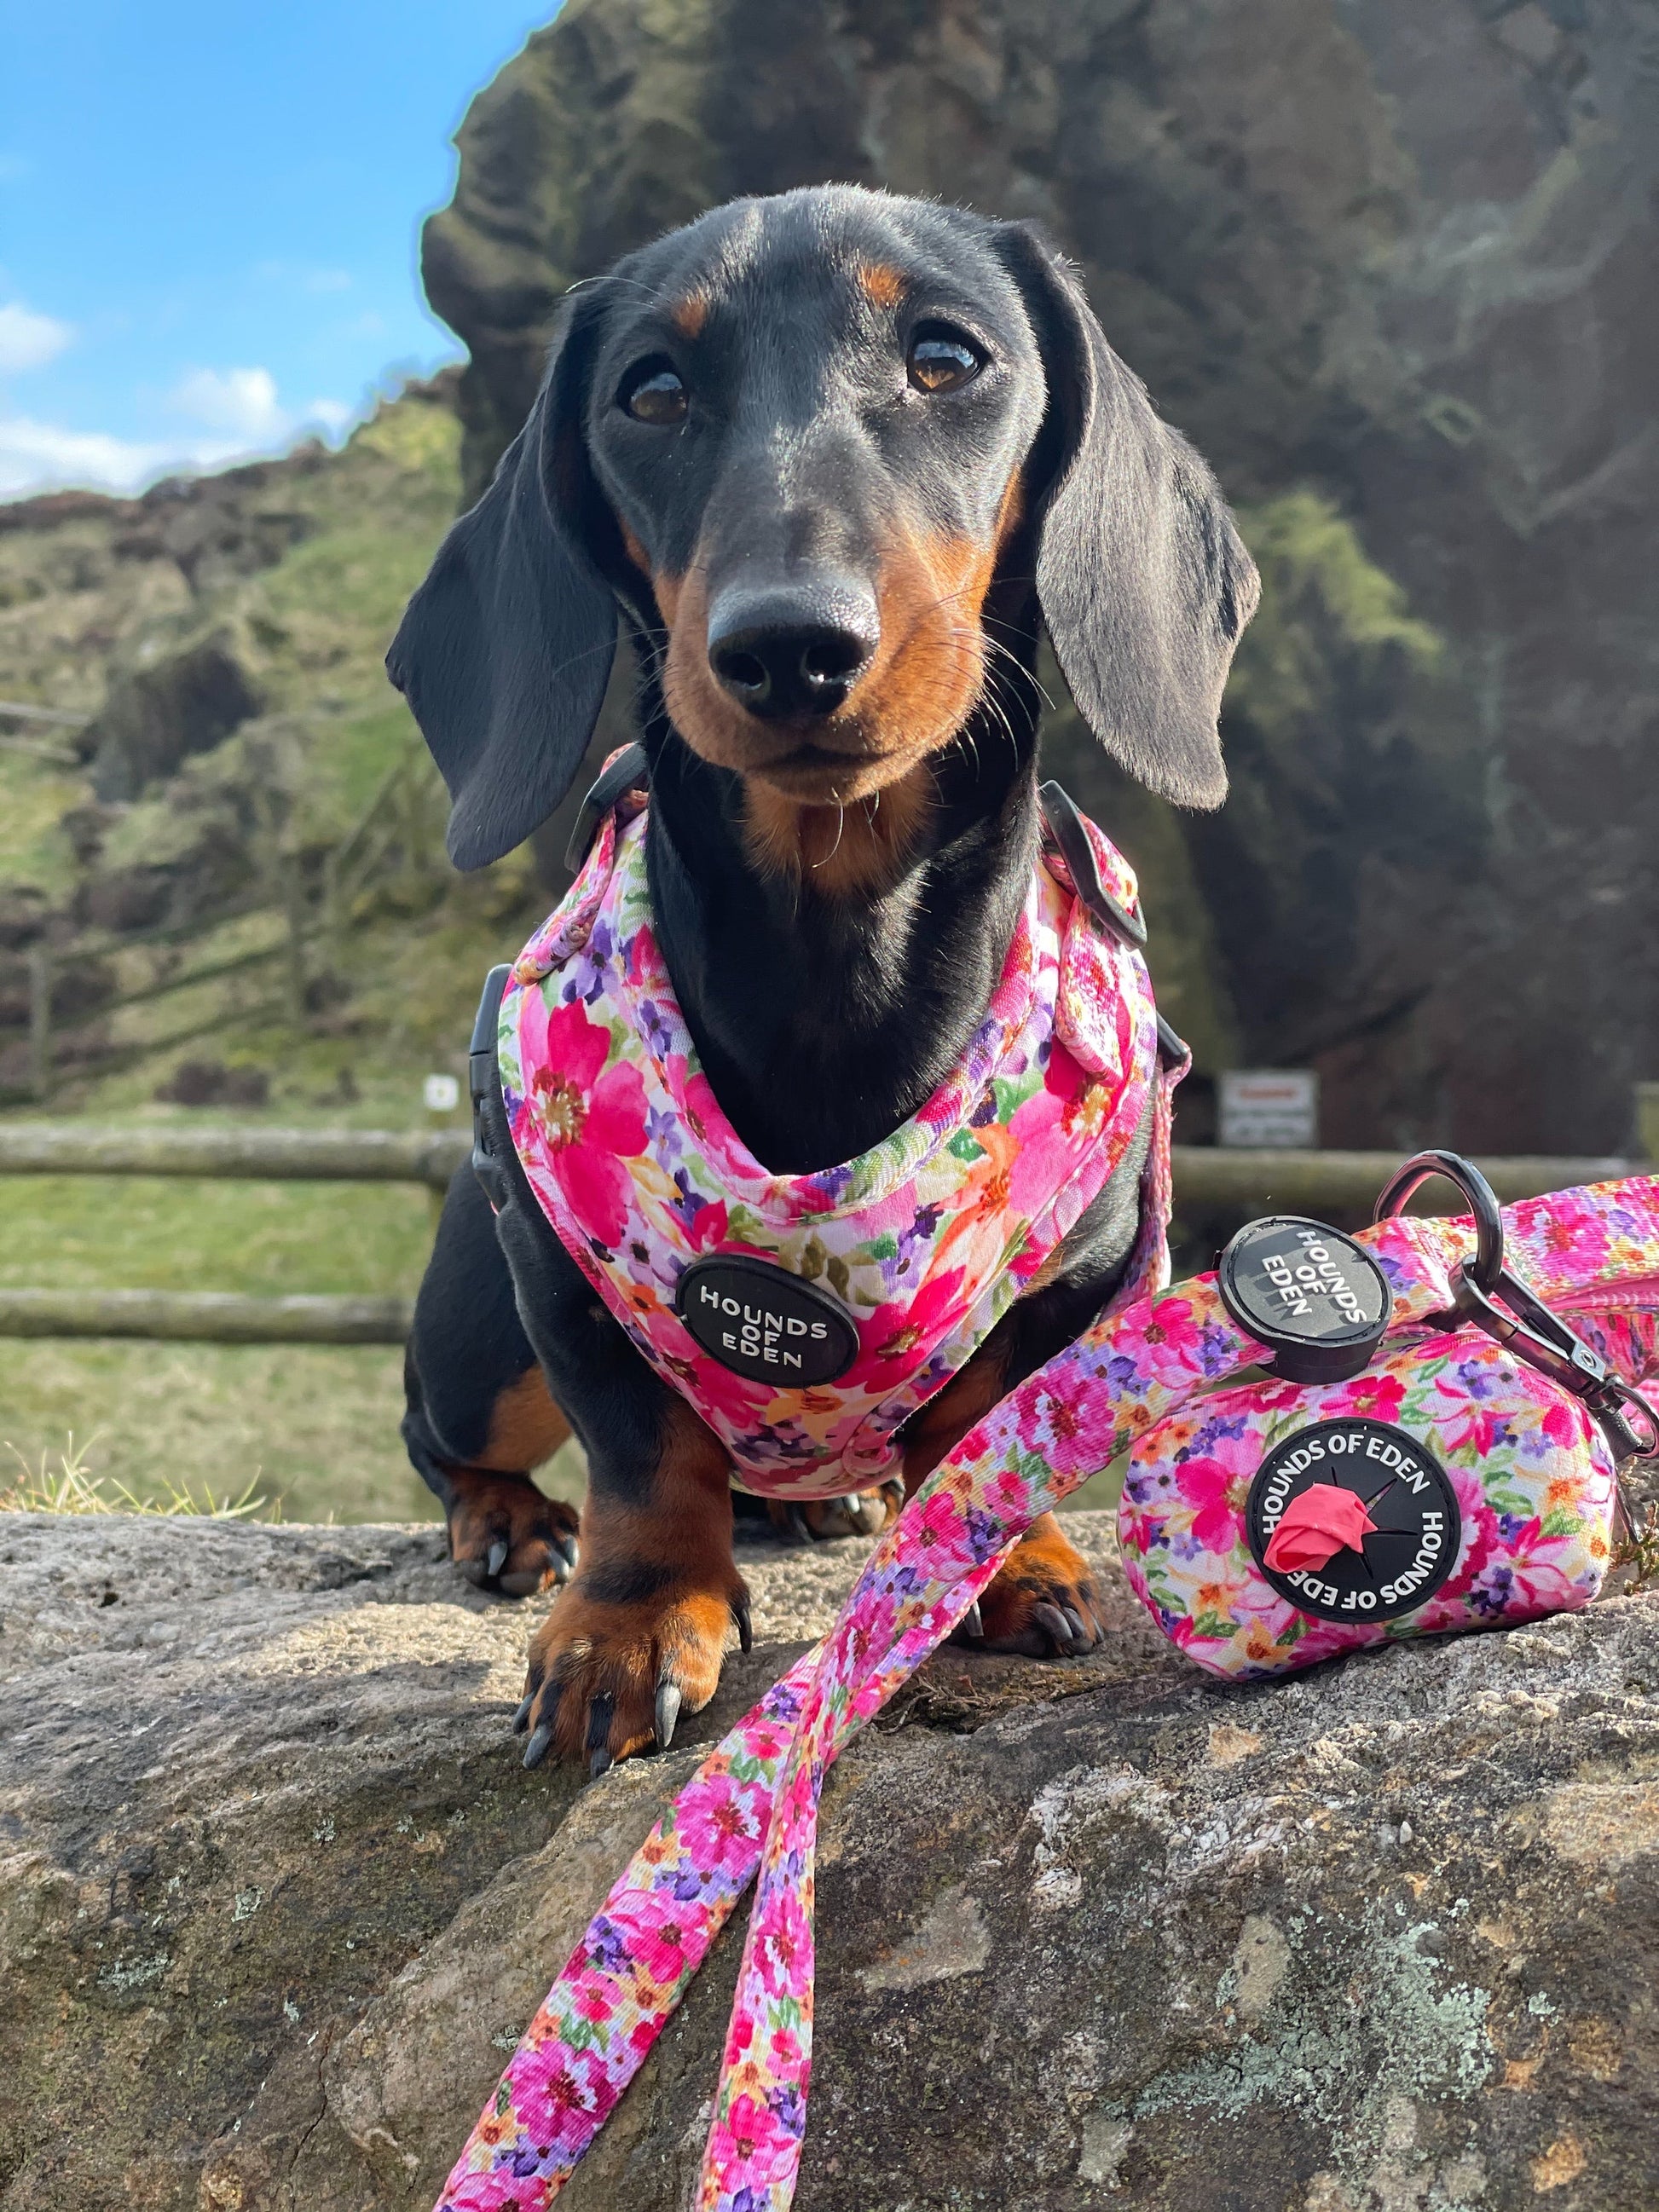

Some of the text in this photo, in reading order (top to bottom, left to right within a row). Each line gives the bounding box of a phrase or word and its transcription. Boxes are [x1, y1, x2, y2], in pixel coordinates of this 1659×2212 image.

[1261, 1255, 1313, 1316] EDEN
[1295, 1265, 1327, 1294] OF
[1296, 1231, 1367, 1324] HOUNDS
[701, 1285, 828, 1339] HOUNDS
[742, 1324, 780, 1346] OF
[722, 1331, 802, 1369] EDEN
[1263, 1434, 1431, 1534] HOUNDS OF EDEN
[1286, 1511, 1444, 1610] HOUNDS OF EDE
